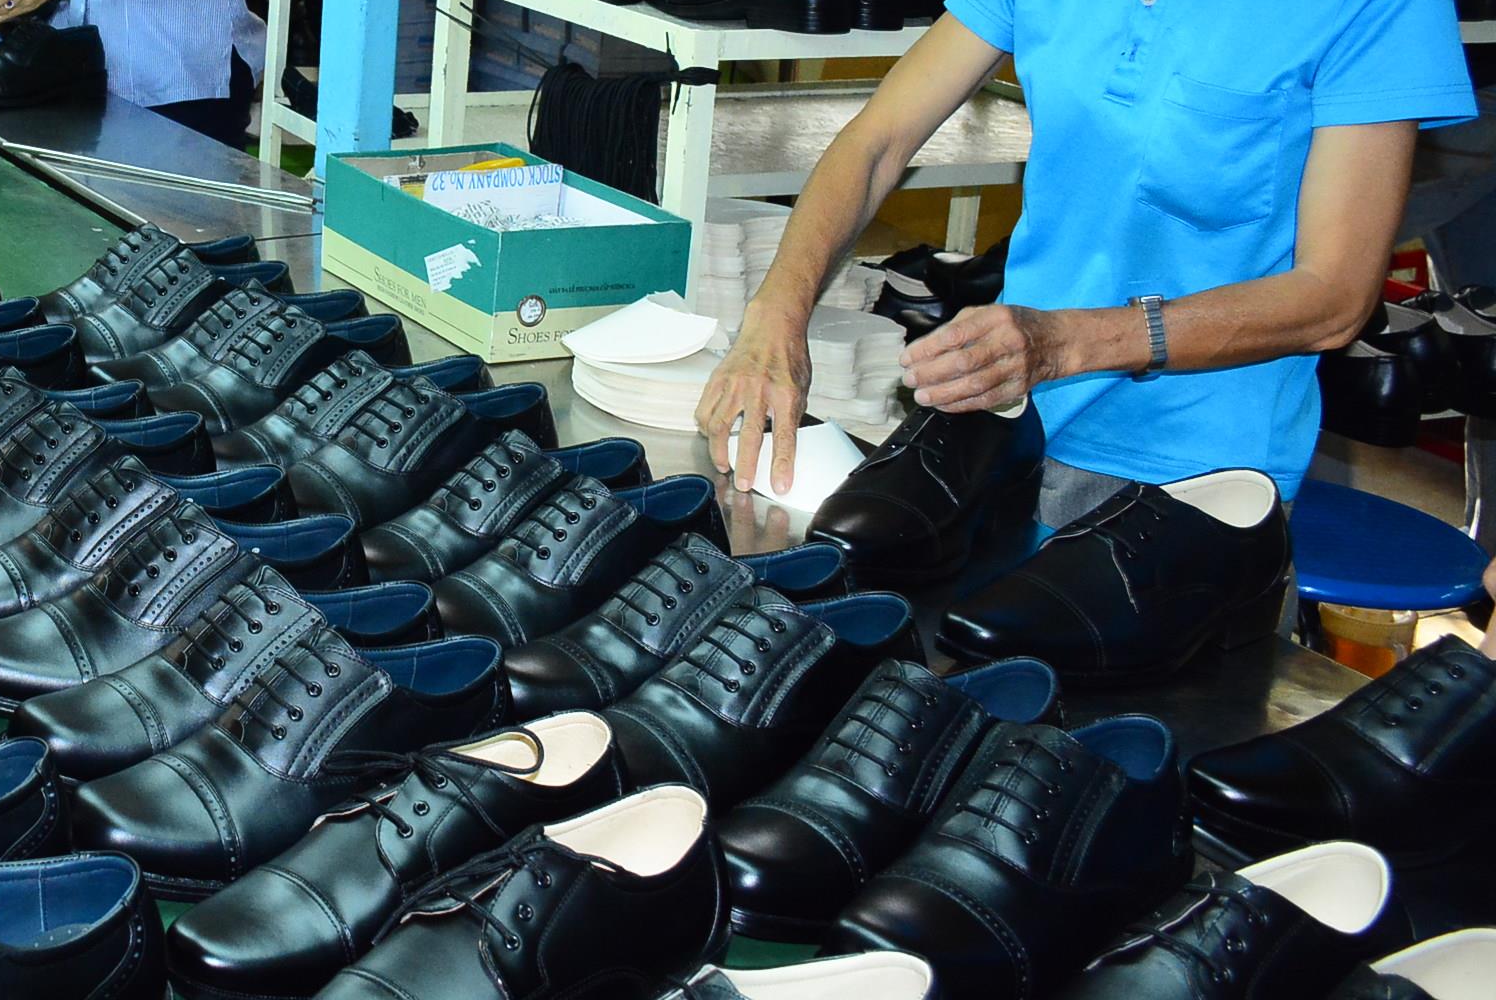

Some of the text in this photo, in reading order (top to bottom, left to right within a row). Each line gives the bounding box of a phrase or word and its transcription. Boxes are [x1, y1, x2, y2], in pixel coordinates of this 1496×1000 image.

[432, 172, 445, 191] 32
[469, 167, 524, 190] COMPANY
[528, 165, 562, 186] STOCK
[507, 328, 551, 345] SHOES
